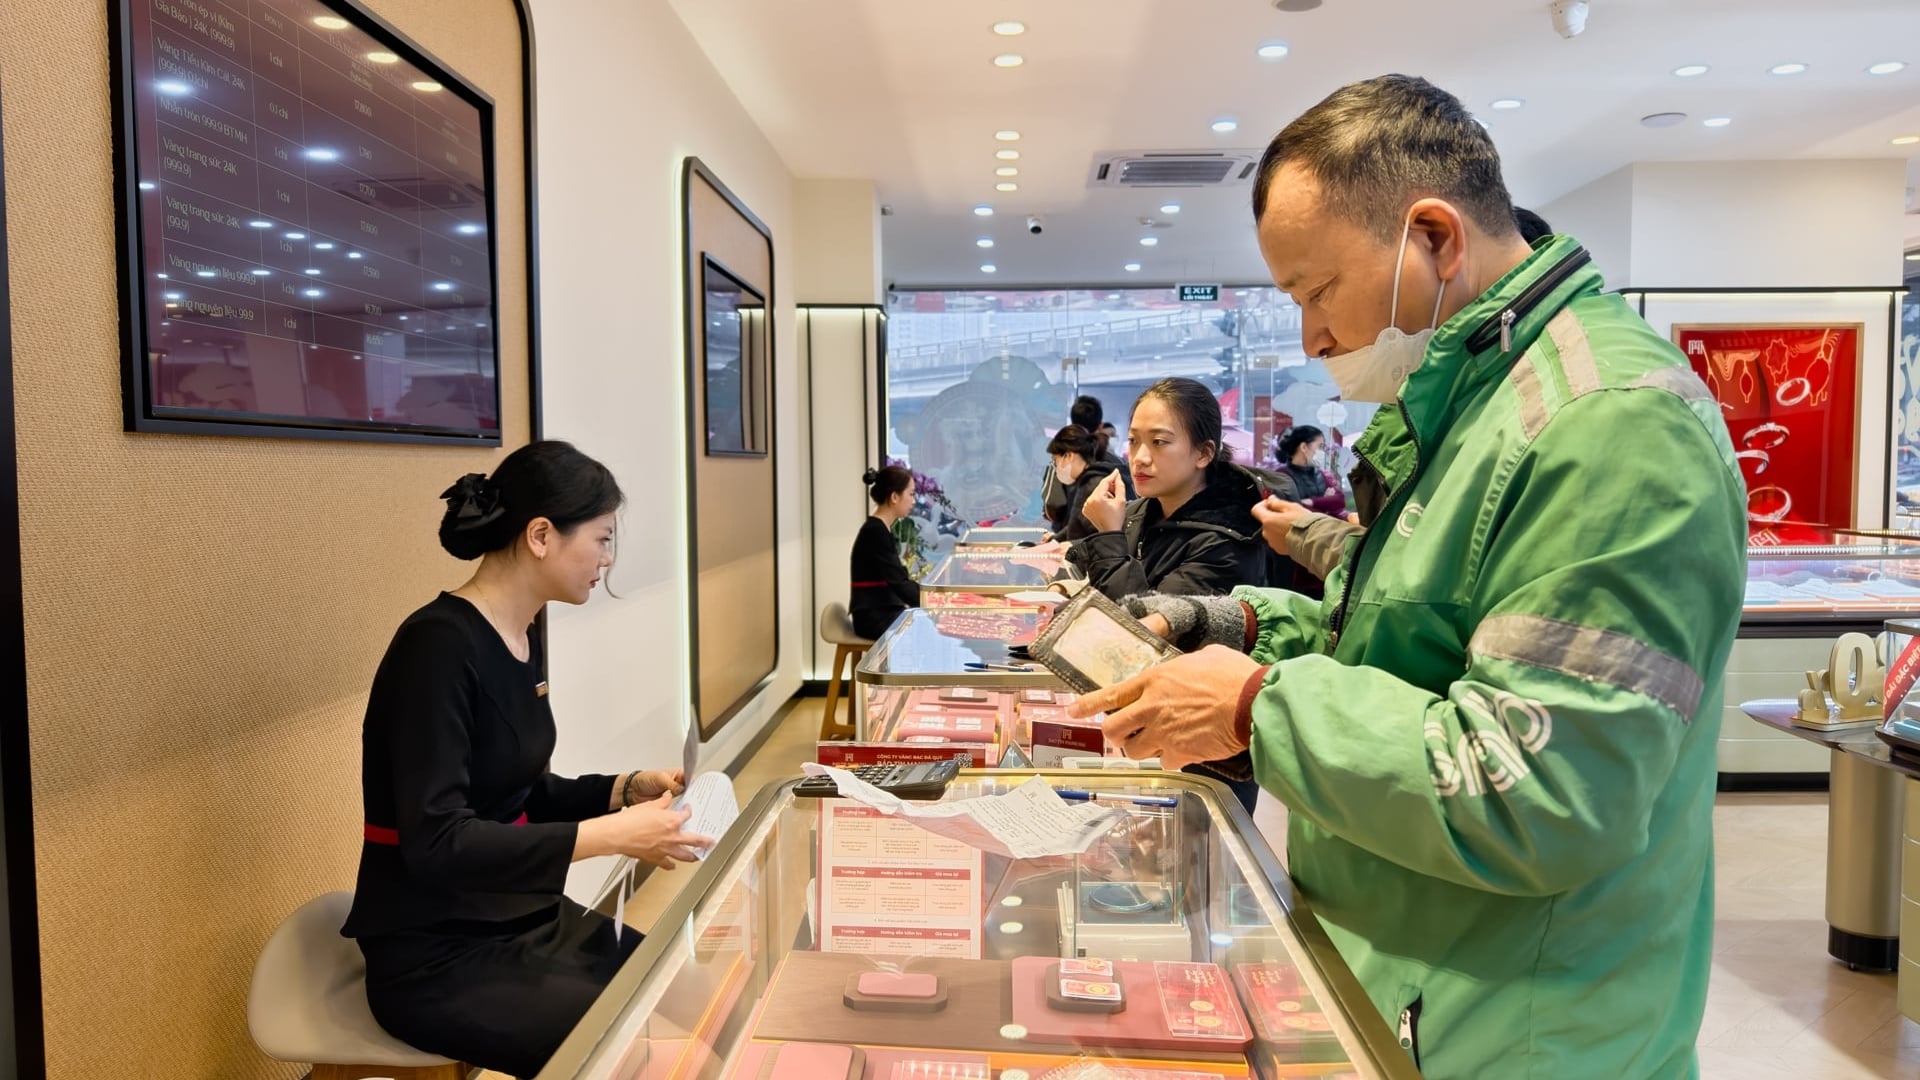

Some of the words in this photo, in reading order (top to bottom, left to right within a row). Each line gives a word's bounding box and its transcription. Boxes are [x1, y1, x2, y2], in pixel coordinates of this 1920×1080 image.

[223, 123, 248, 144] BTMH
[223, 160, 238, 176] 24K
[226, 214, 240, 229] 24K
[1184, 286, 1213, 294] EXIT
